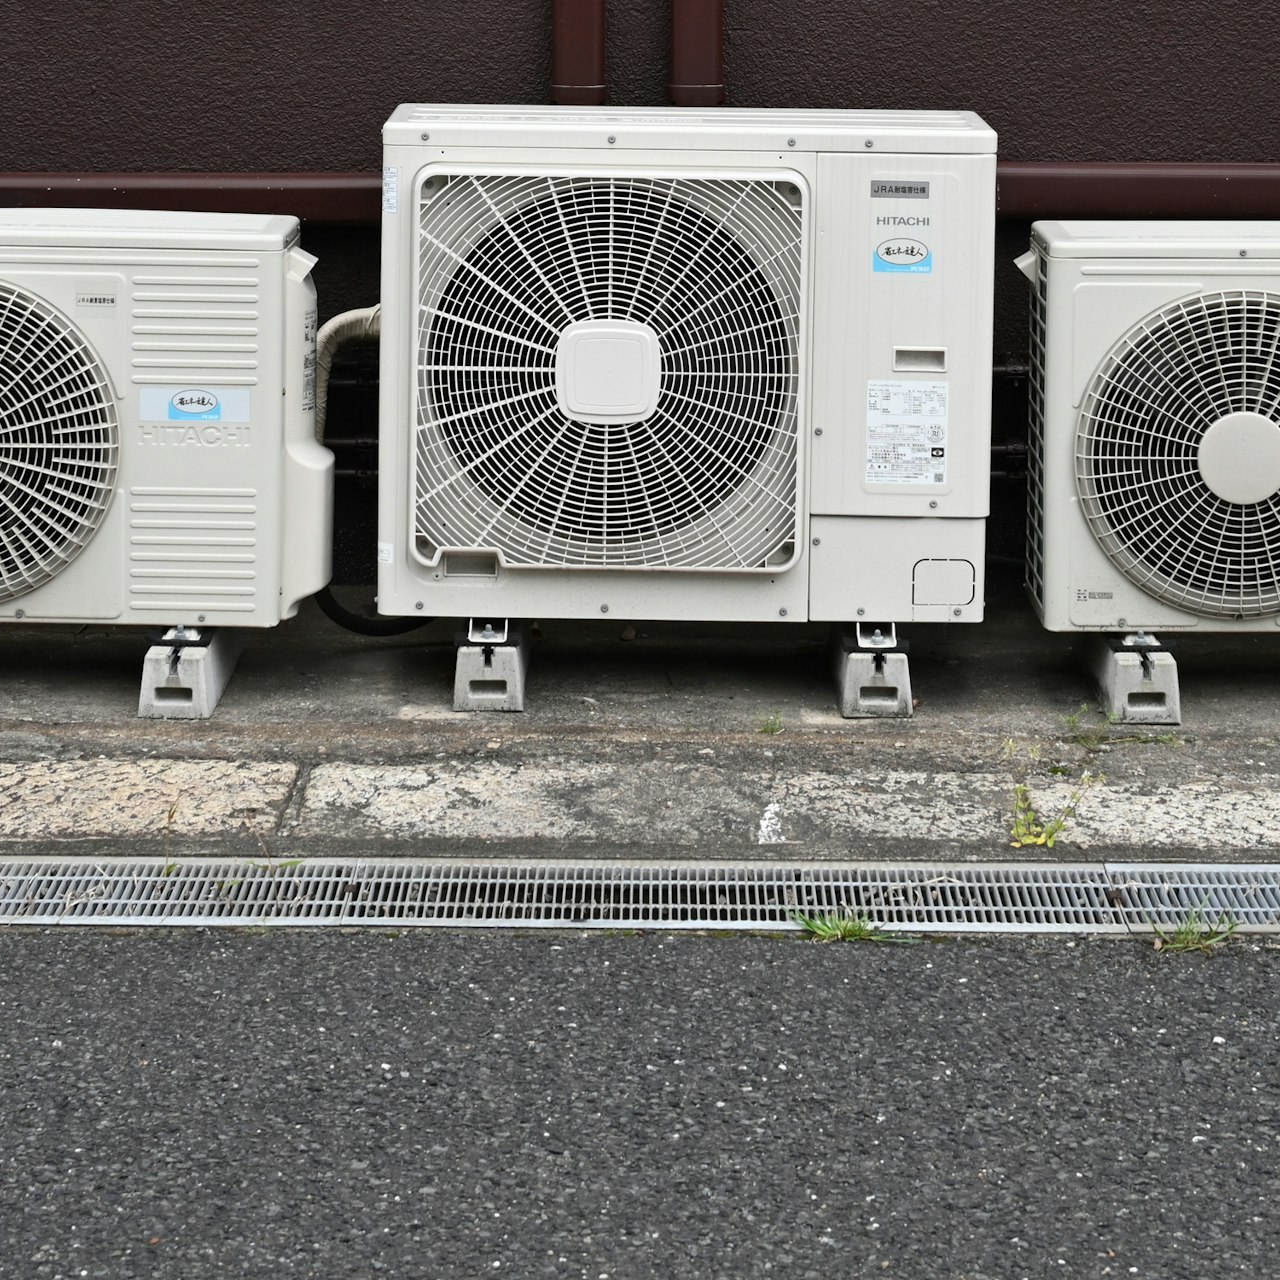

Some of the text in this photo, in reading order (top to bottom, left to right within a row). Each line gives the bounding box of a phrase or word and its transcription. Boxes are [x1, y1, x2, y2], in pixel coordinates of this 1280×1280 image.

[874, 185, 926, 194] JRA耐塩害仕様
[876, 216, 930, 226] HITACHI
[138, 426, 250, 447] HITACHI
